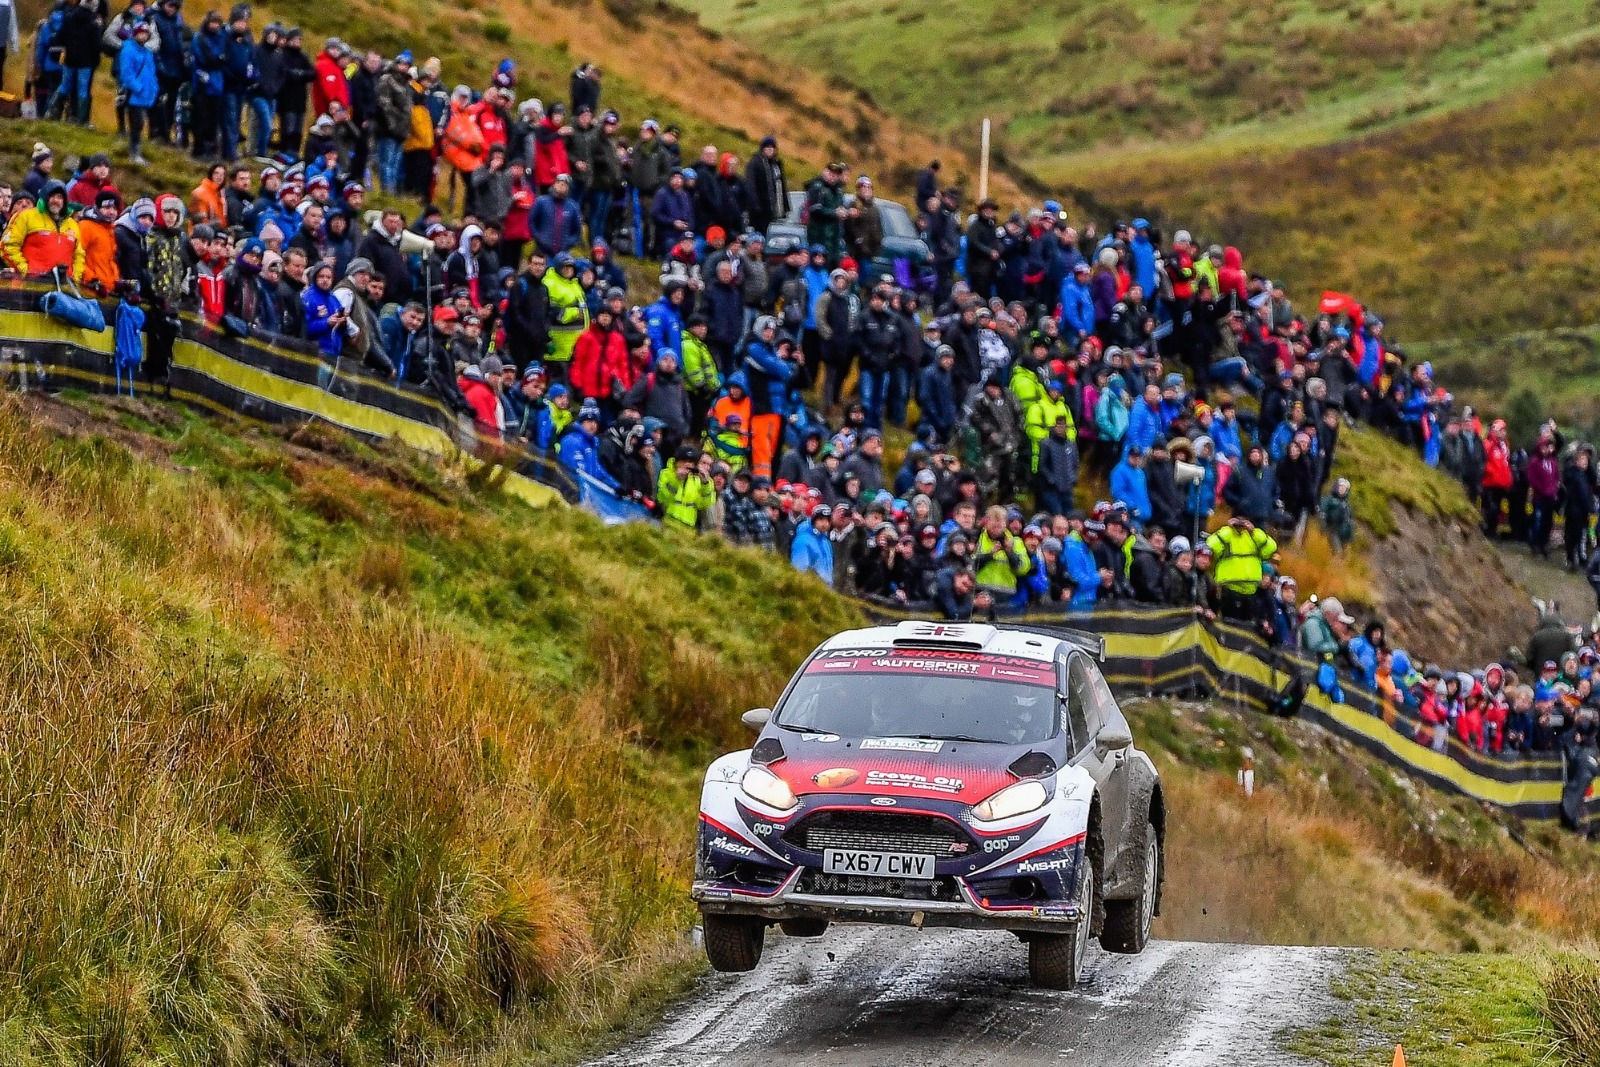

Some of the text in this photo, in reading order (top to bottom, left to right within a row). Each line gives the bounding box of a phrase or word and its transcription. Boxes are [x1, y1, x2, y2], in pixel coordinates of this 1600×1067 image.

[829, 650, 887, 658] FORD
[889, 648, 1053, 670] PERFORMANCE
[879, 659, 980, 671] AUTOSPORT
[867, 770, 926, 782] Crown
[753, 822, 773, 837] gap
[949, 843, 968, 851] RS
[984, 839, 1009, 853] gap
[832, 852, 925, 875] PX67 CWV
[1027, 859, 1068, 872] MS-RT
